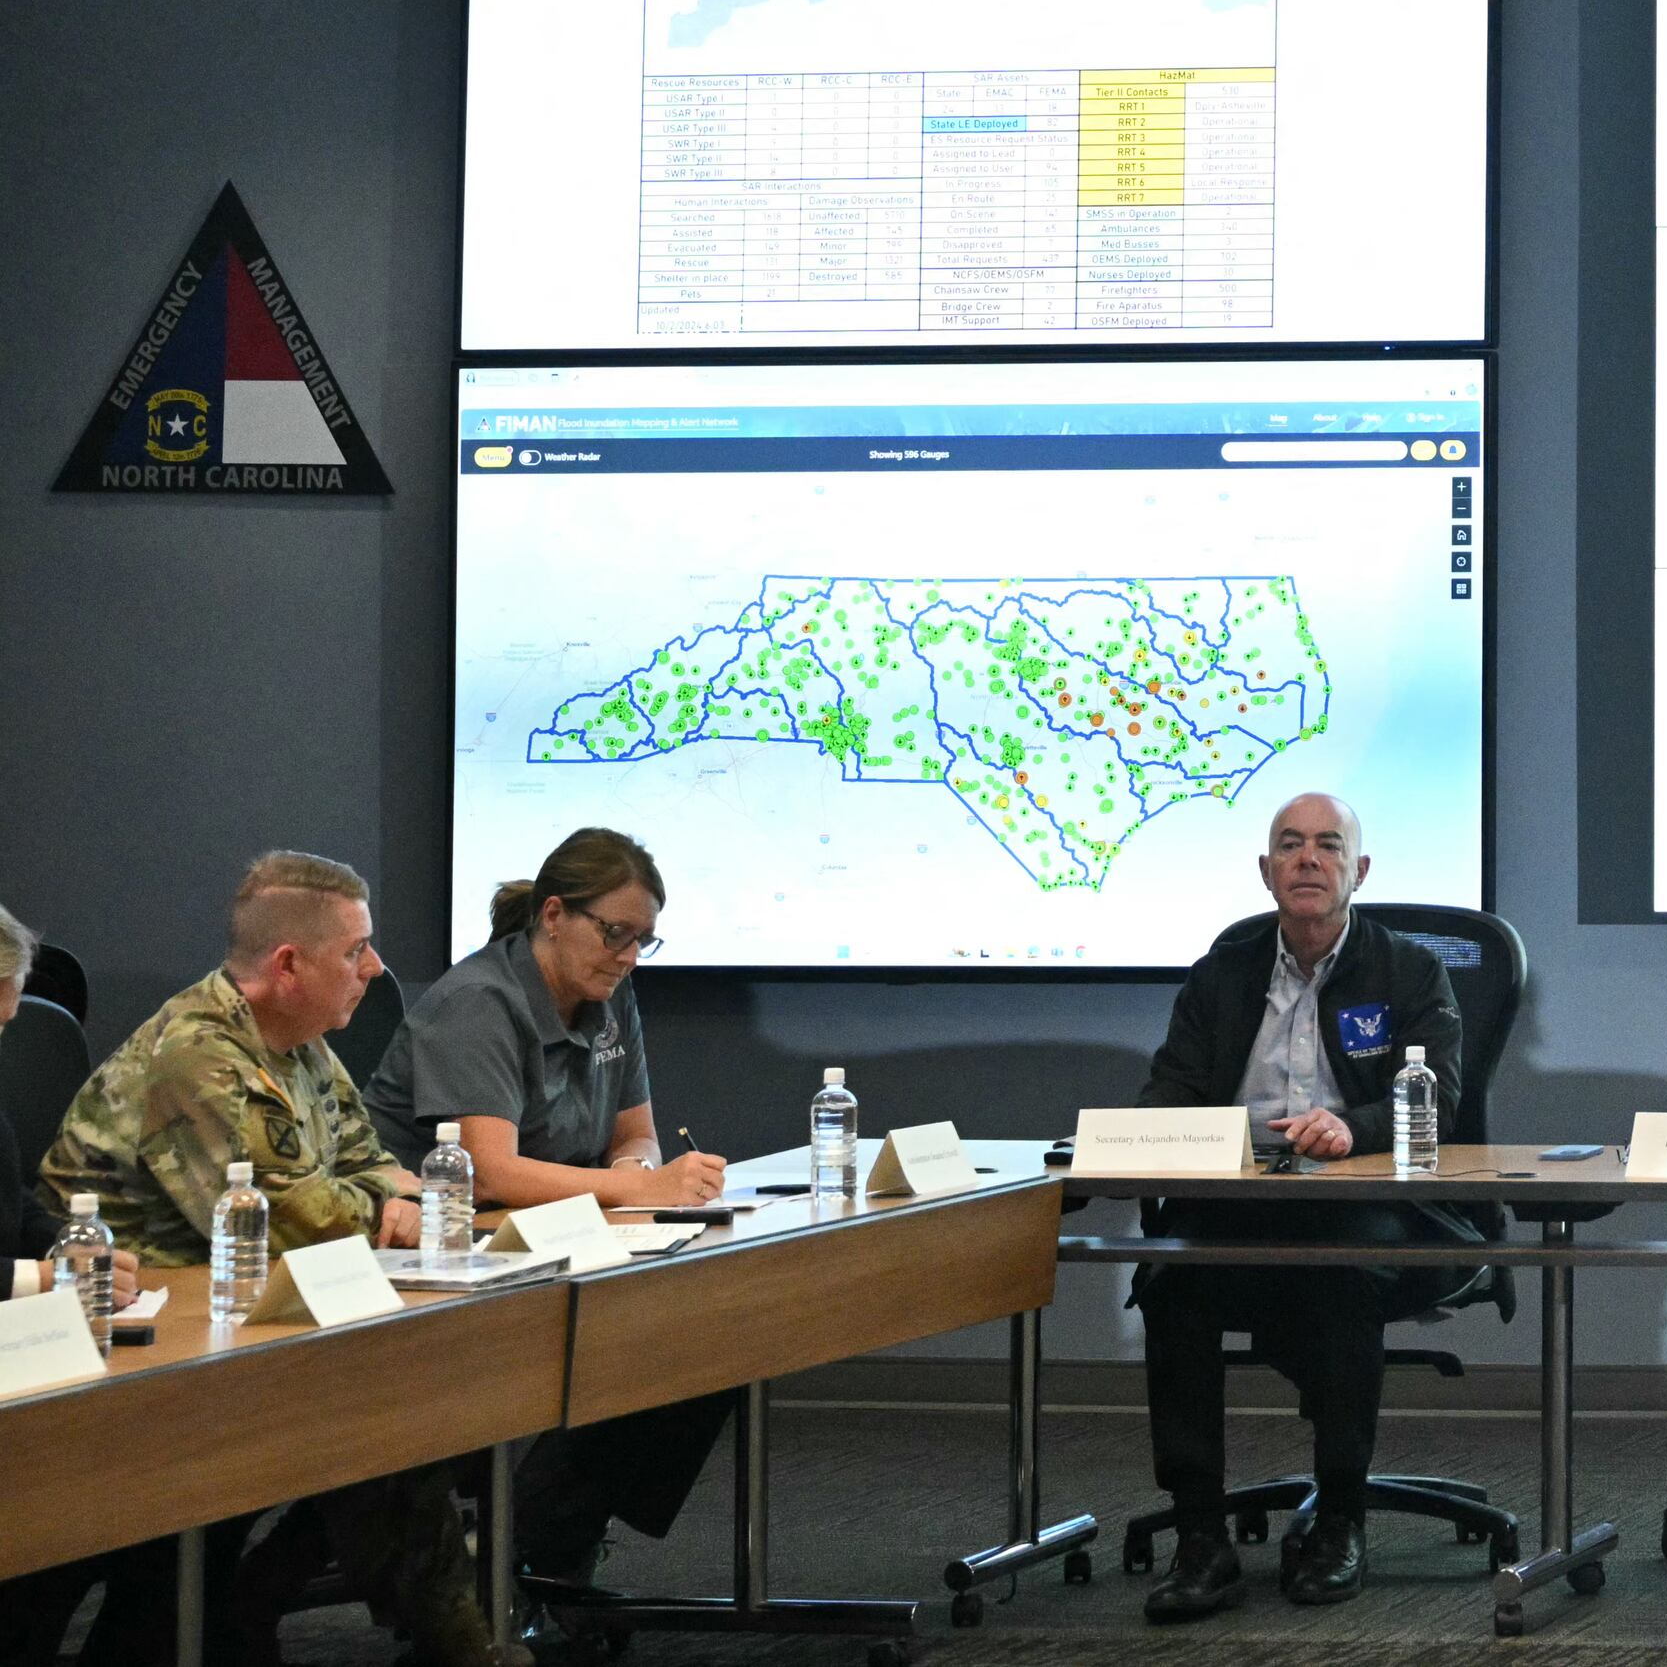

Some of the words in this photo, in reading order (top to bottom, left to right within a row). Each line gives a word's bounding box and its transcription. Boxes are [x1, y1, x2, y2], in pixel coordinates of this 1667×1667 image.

[1160, 71, 1195, 80] HazMat
[1096, 88, 1113, 97] Tier
[1126, 88, 1168, 96] Contacts
[1119, 103, 1139, 111] RRT
[931, 120, 956, 129] State
[959, 120, 970, 128] LE
[974, 120, 1019, 132] Deployed
[1140, 118, 1146, 126] 2
[1118, 134, 1139, 142] RRT
[1140, 134, 1145, 142] 3
[1140, 148, 1145, 156] 4
[1118, 164, 1138, 172] RRT
[1140, 178, 1145, 186] 6
[1117, 194, 1138, 202] RRT
[1101, 225, 1160, 233] Ambulances
[1101, 240, 1120, 248] Med
[1124, 240, 1159, 248] Busses
[1092, 255, 1120, 263] OEMS
[1124, 255, 1168, 266] Deployed
[934, 285, 980, 294] Chainsaw
[984, 285, 1008, 293] Crew
[1102, 286, 1158, 296] Firefighters
[942, 302, 972, 314] Bridge
[976, 302, 1001, 311] Crew
[942, 316, 959, 324] IMT
[962, 316, 1000, 326] Support
[110, 260, 203, 411] EMERGENCY
[247, 257, 352, 429] MANAGEMENT
[148, 415, 161, 437] N
[193, 415, 207, 437] C
[496, 416, 557, 433] FIMAN
[558, 419, 582, 428] Flood
[584, 418, 630, 428] Inundation
[632, 418, 669, 429] Mapping
[680, 418, 700, 427] Alert
[702, 417, 738, 427] Network
[544, 453, 576, 462] Weather
[578, 453, 600, 461] Radar
[869, 450, 903, 461] Showing
[920, 451, 949, 460] Gauges
[102, 465, 195, 488] NORTH
[205, 466, 344, 489] CAROLINA
[1095, 1135, 1135, 1146] Secretary
[1138, 1135, 1180, 1146] Alejandro
[1183, 1135, 1225, 1145] Mayorkas
